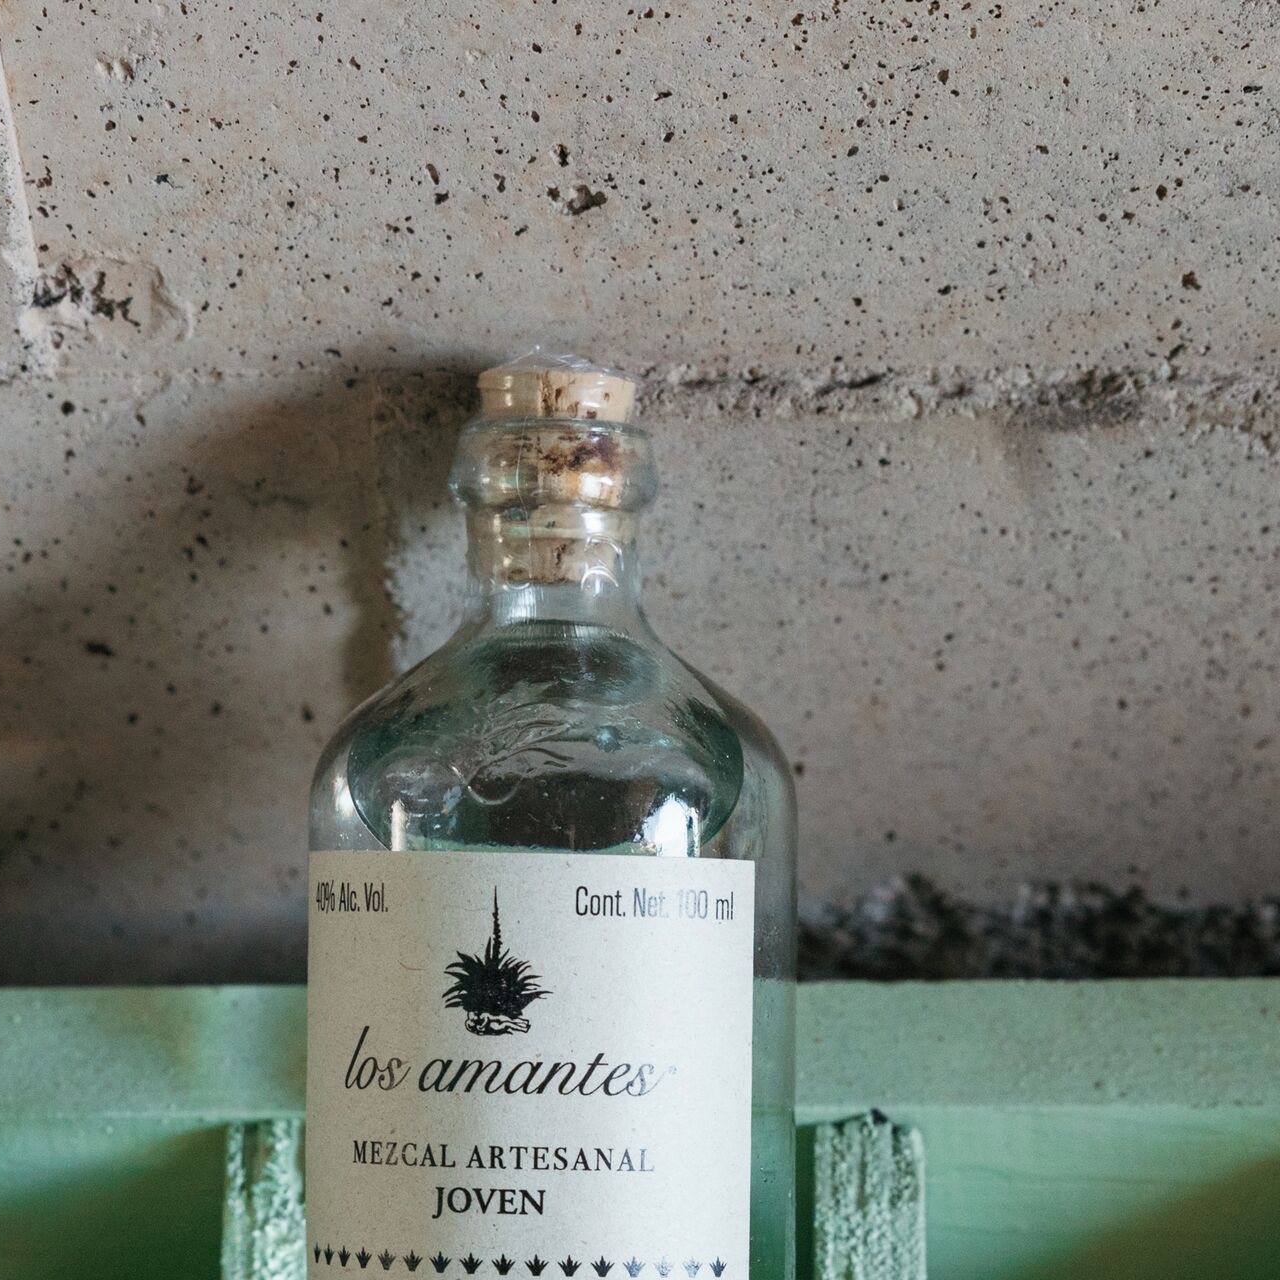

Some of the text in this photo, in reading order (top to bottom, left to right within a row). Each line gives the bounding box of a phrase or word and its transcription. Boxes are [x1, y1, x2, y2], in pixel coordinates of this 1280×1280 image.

[338, 882, 360, 913] Alc.
[364, 882, 389, 913] Vol.
[575, 885, 734, 920] Cont. Net. 100 ml
[344, 1025, 666, 1097] los amantes
[352, 1140, 656, 1173] MEZCAL ARTESANAL
[431, 1186, 546, 1219] JOVEN
